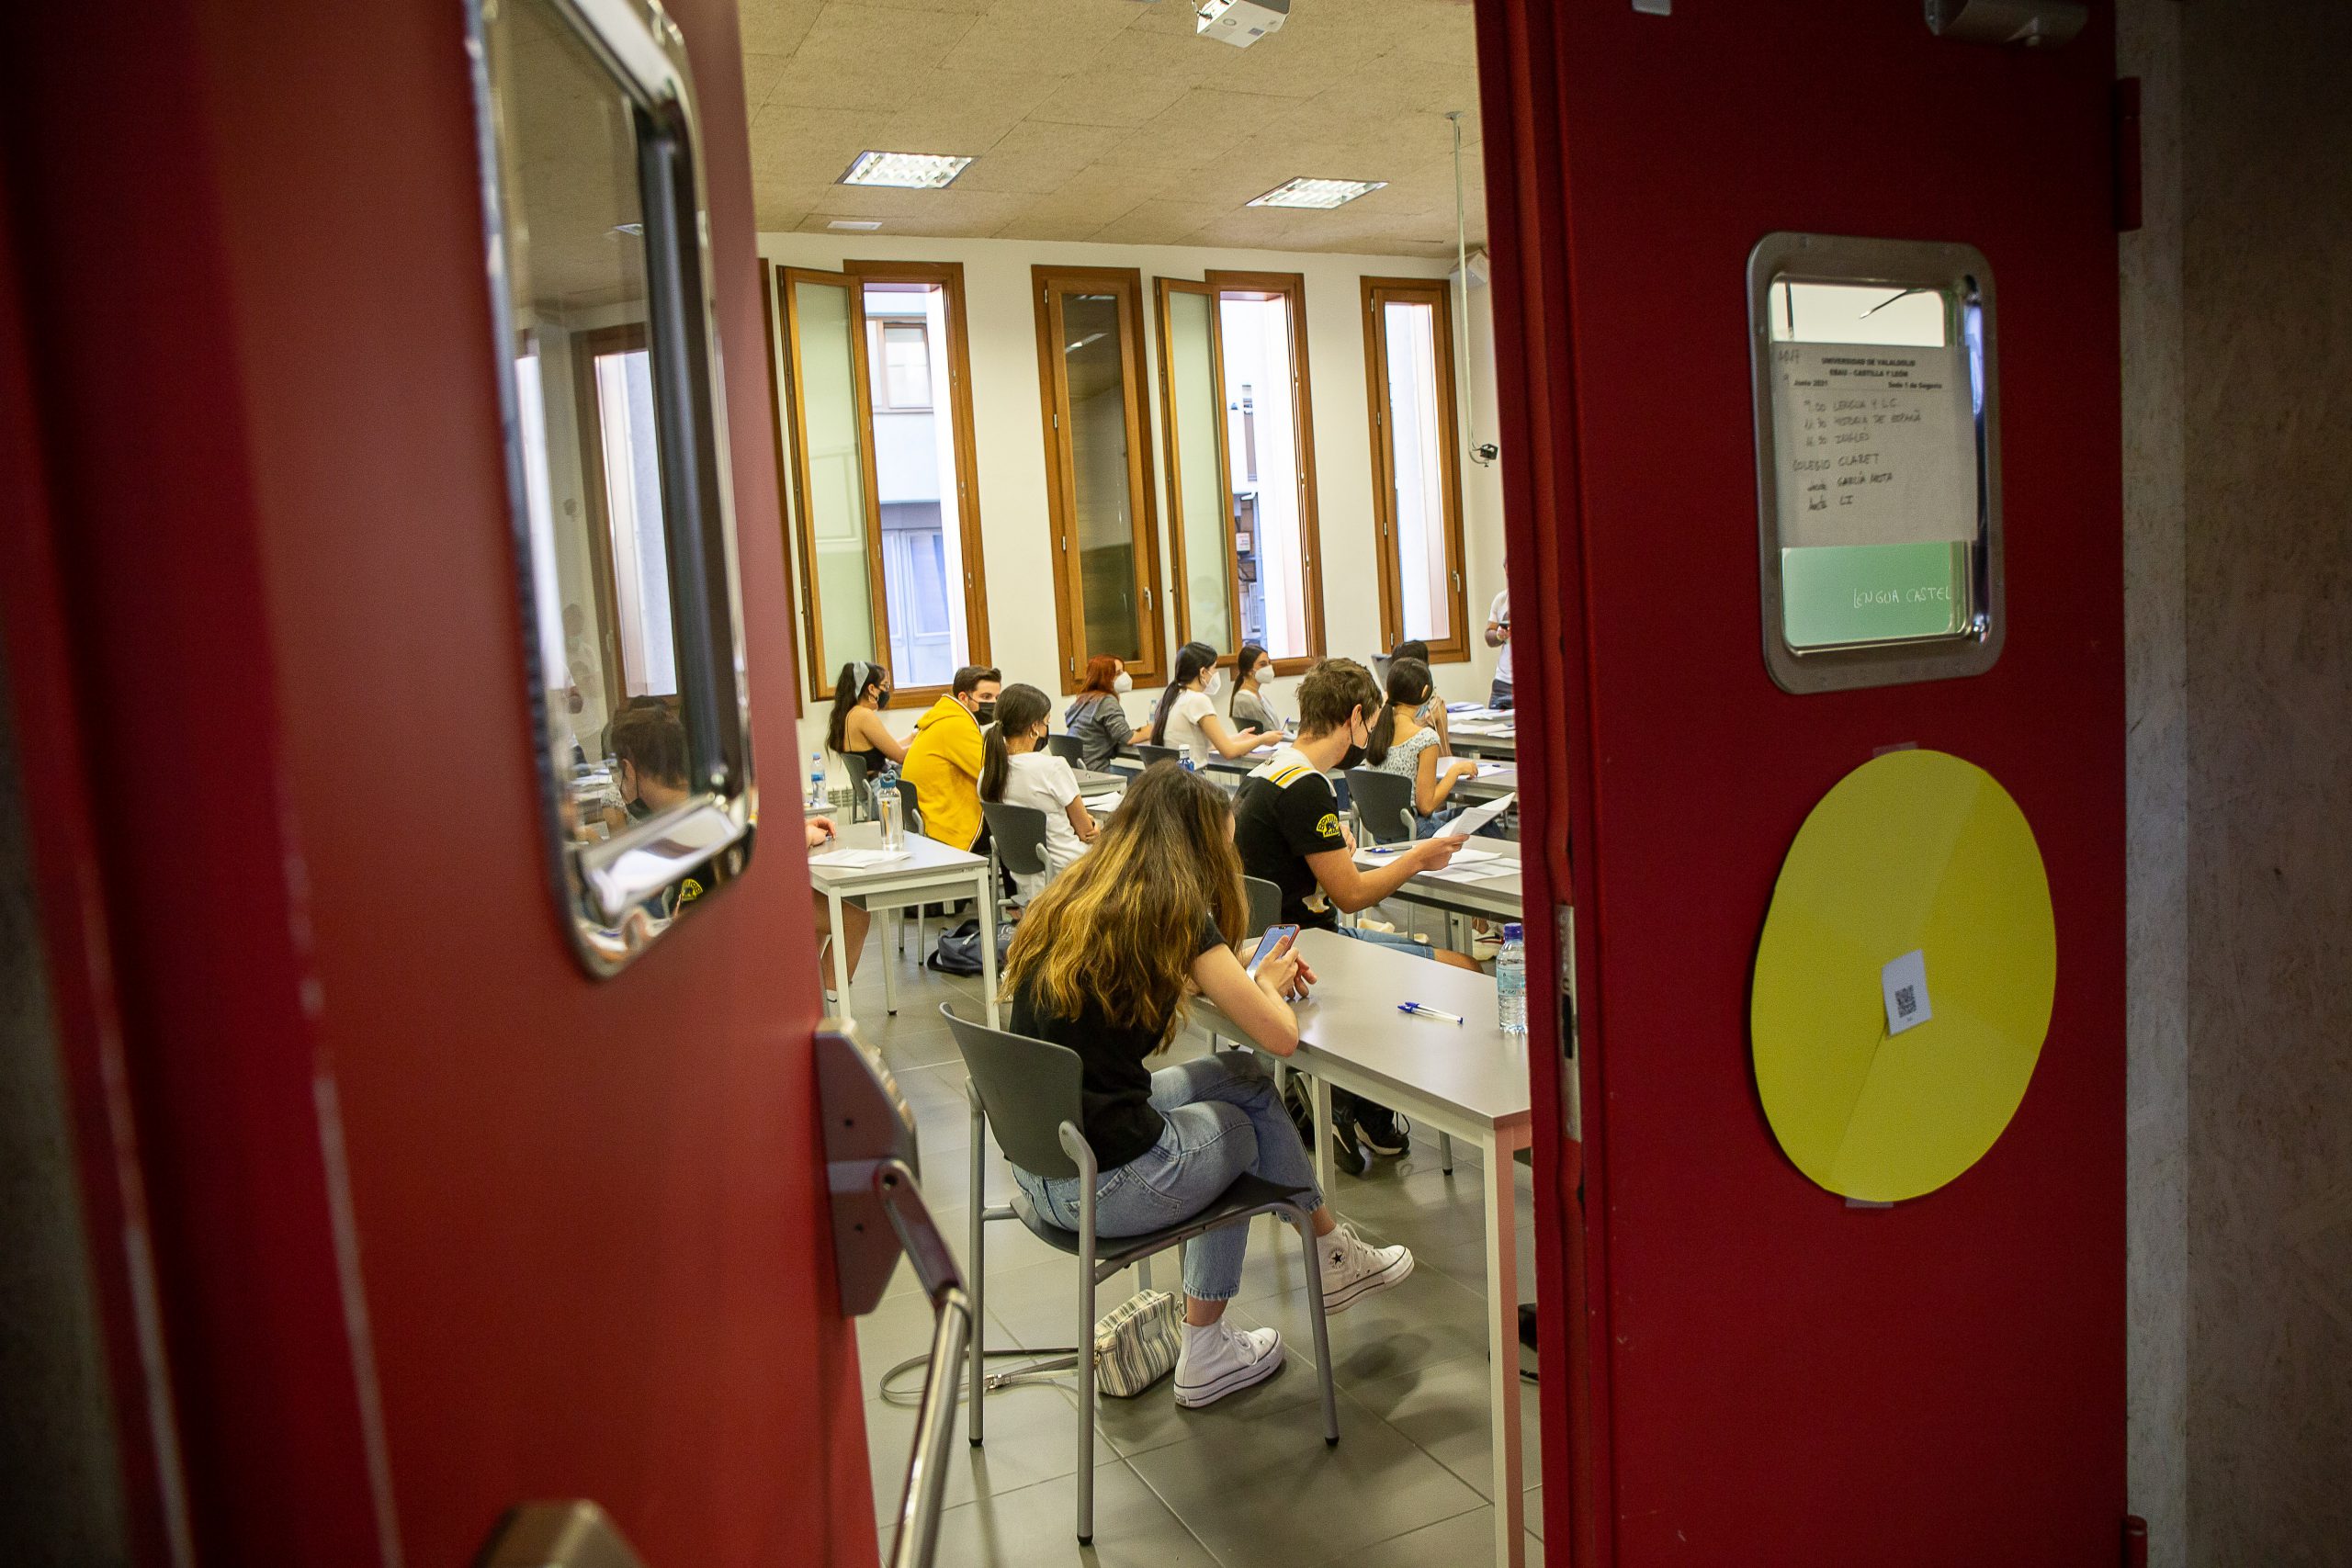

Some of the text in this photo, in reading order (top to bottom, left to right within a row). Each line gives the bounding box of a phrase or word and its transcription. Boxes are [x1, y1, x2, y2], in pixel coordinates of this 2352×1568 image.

[1822, 357, 1866, 366] UNIVERSIDAD
[1829, 368, 1849, 377] EBAU
[1838, 453, 1880, 467] CLARET
